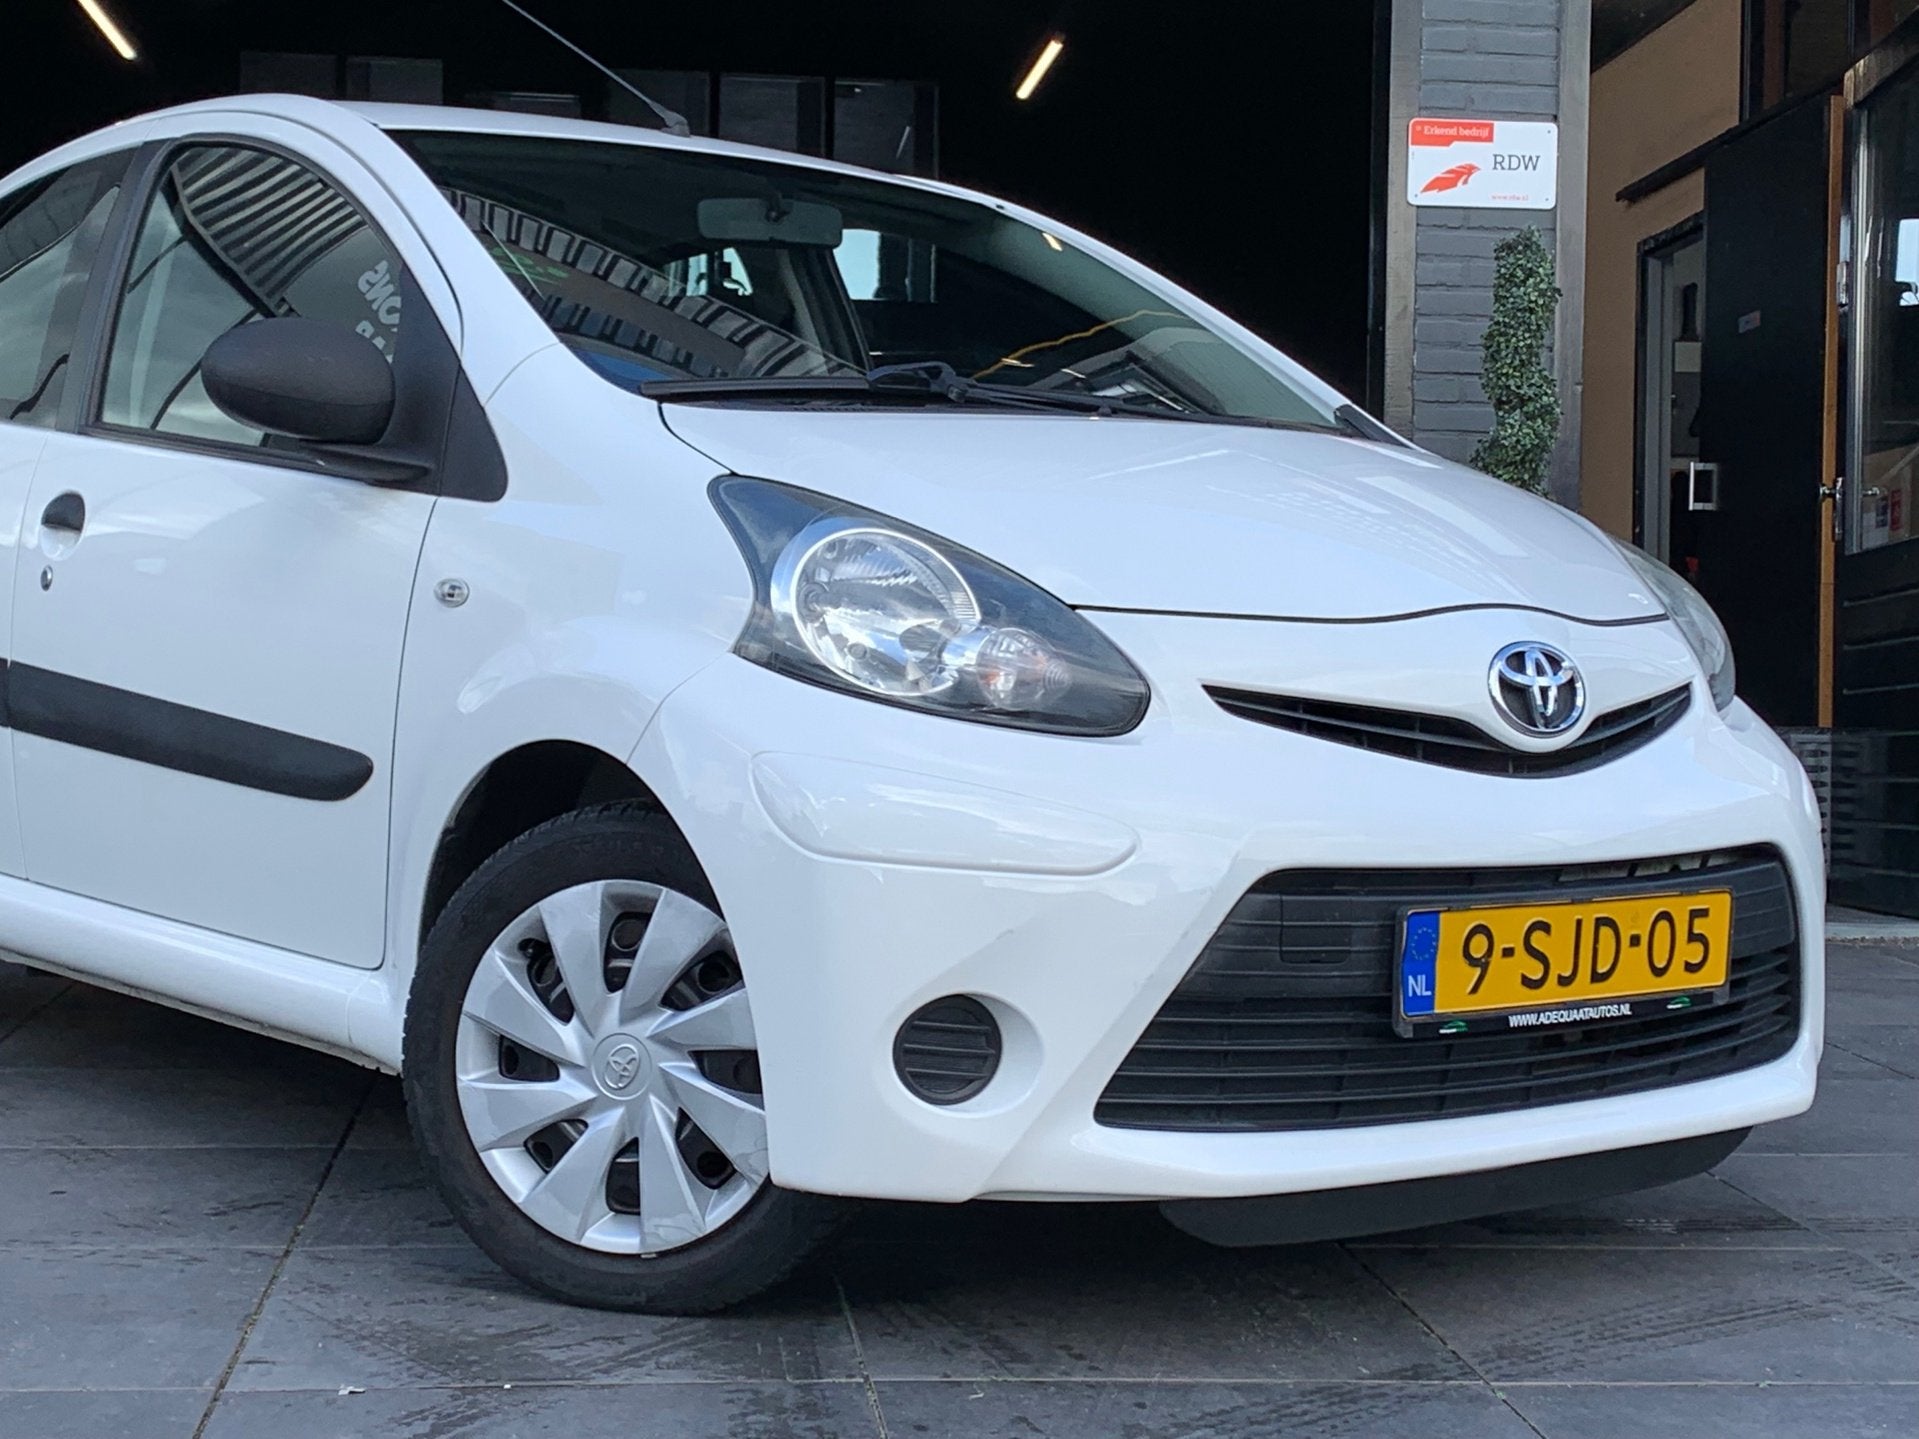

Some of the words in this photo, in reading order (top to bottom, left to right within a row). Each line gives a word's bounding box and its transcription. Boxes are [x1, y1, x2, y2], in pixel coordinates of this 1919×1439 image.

[1424, 125, 1458, 136] Erkend
[1459, 126, 1489, 139] bedrijf
[1492, 154, 1541, 171] RDW
[1462, 907, 1710, 995] 9-SJD-05
[1408, 975, 1432, 997] NL
[1508, 1003, 1632, 1028] WWW.ADEQUAATAUTOS.NL
